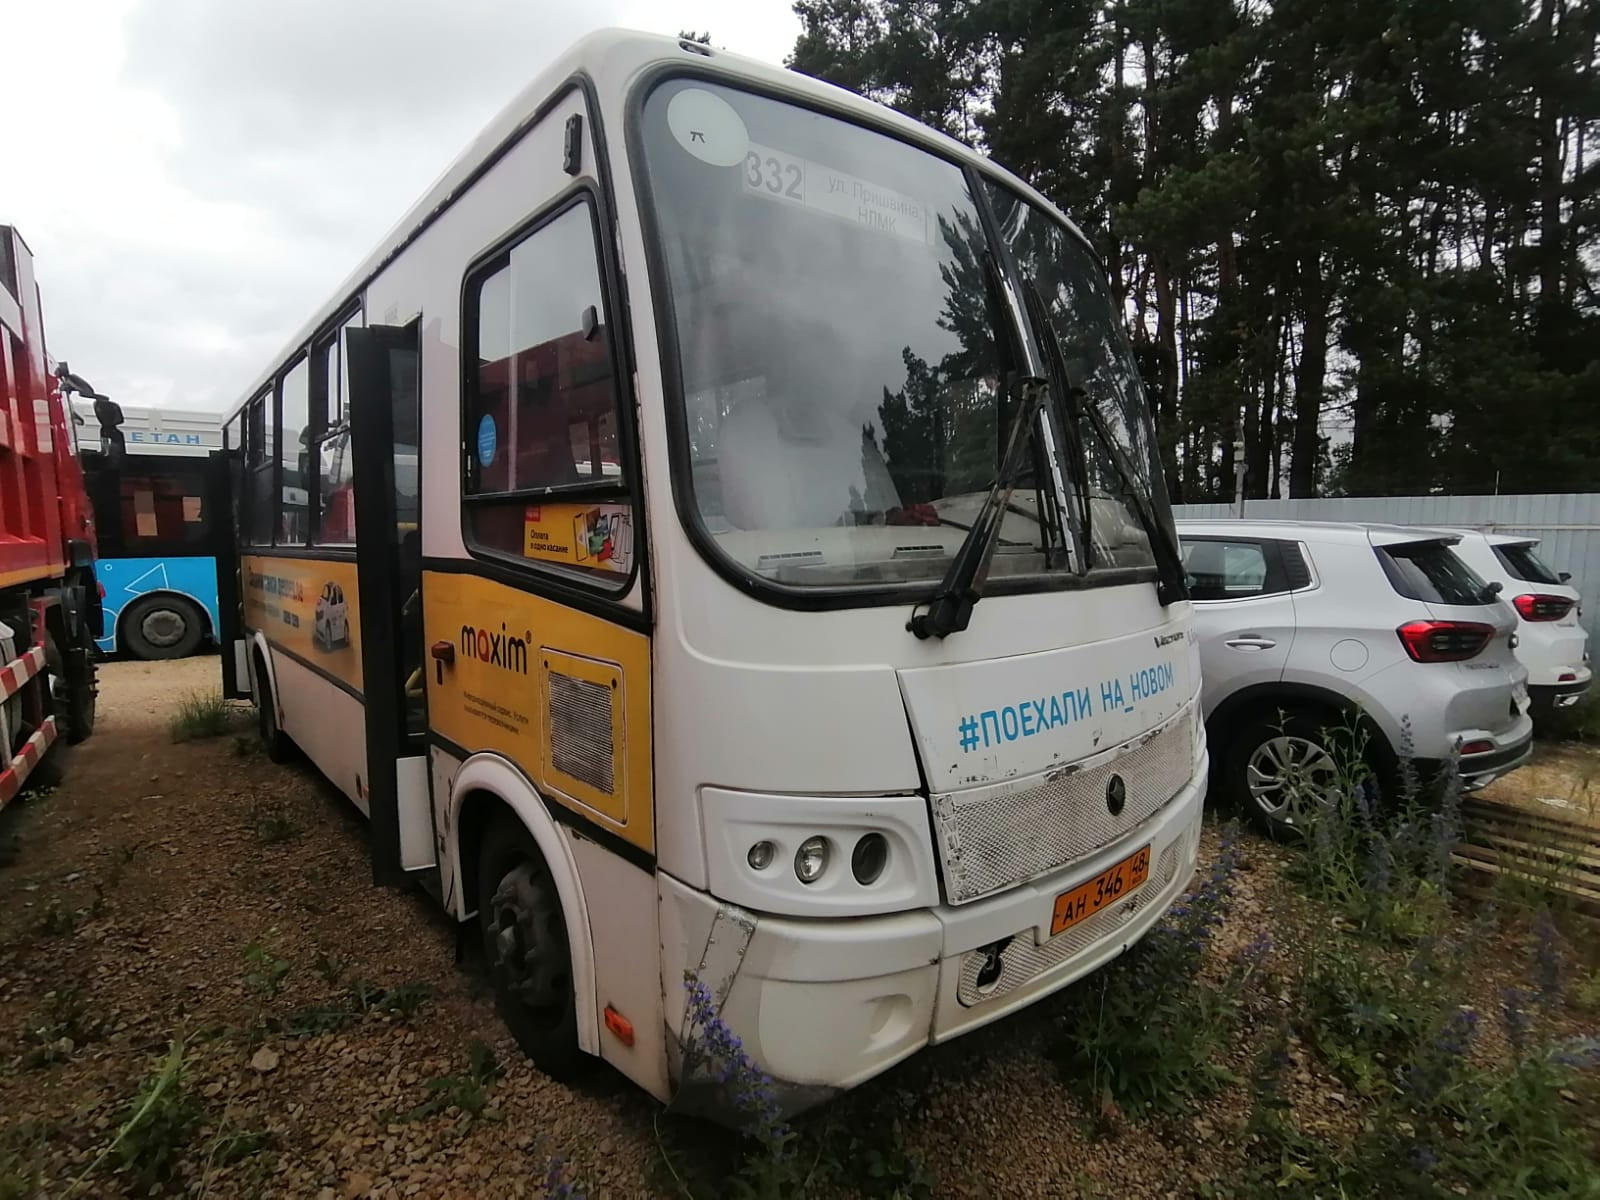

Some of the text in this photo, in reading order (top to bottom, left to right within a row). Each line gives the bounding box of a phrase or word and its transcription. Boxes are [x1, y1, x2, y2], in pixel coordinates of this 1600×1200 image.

[745, 151, 803, 201] 332
[827, 176, 848, 194] ул.
[857, 206, 898, 233] НЛМК
[461, 622, 528, 675] maxim
[958, 661, 1175, 753] #ПОЕХАЛИ НА_НОВОМ
[1093, 867, 1124, 907] 346
[1131, 852, 1146, 875] 48
